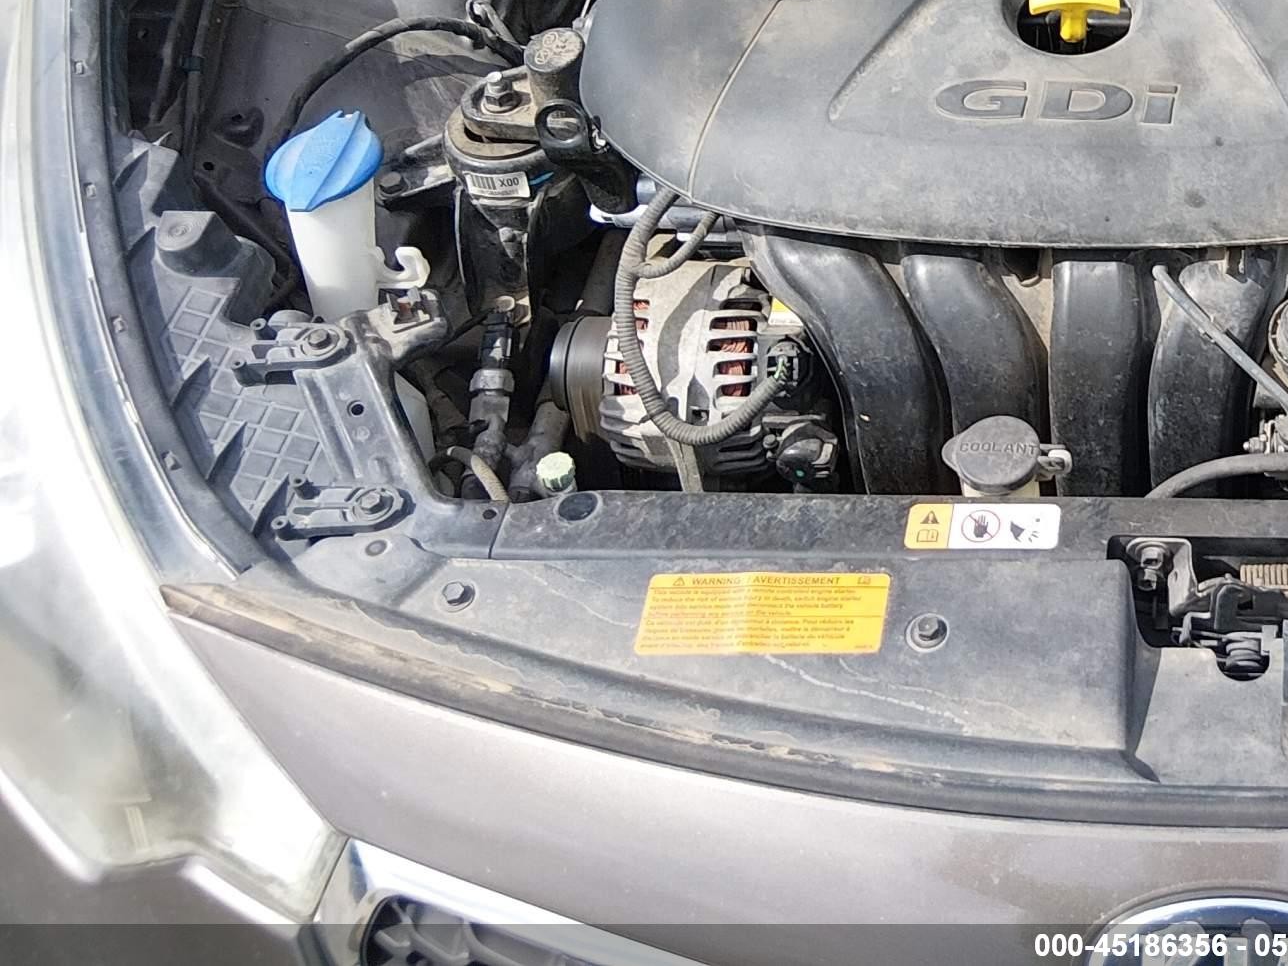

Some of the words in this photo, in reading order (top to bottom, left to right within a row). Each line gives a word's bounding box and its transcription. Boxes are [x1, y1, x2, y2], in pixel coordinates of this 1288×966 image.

[935, 79, 1181, 126] GDi
[960, 441, 1039, 455] COOLANT
[691, 576, 741, 585] WARNING
[752, 575, 840, 585] AVERTISSEMENT
